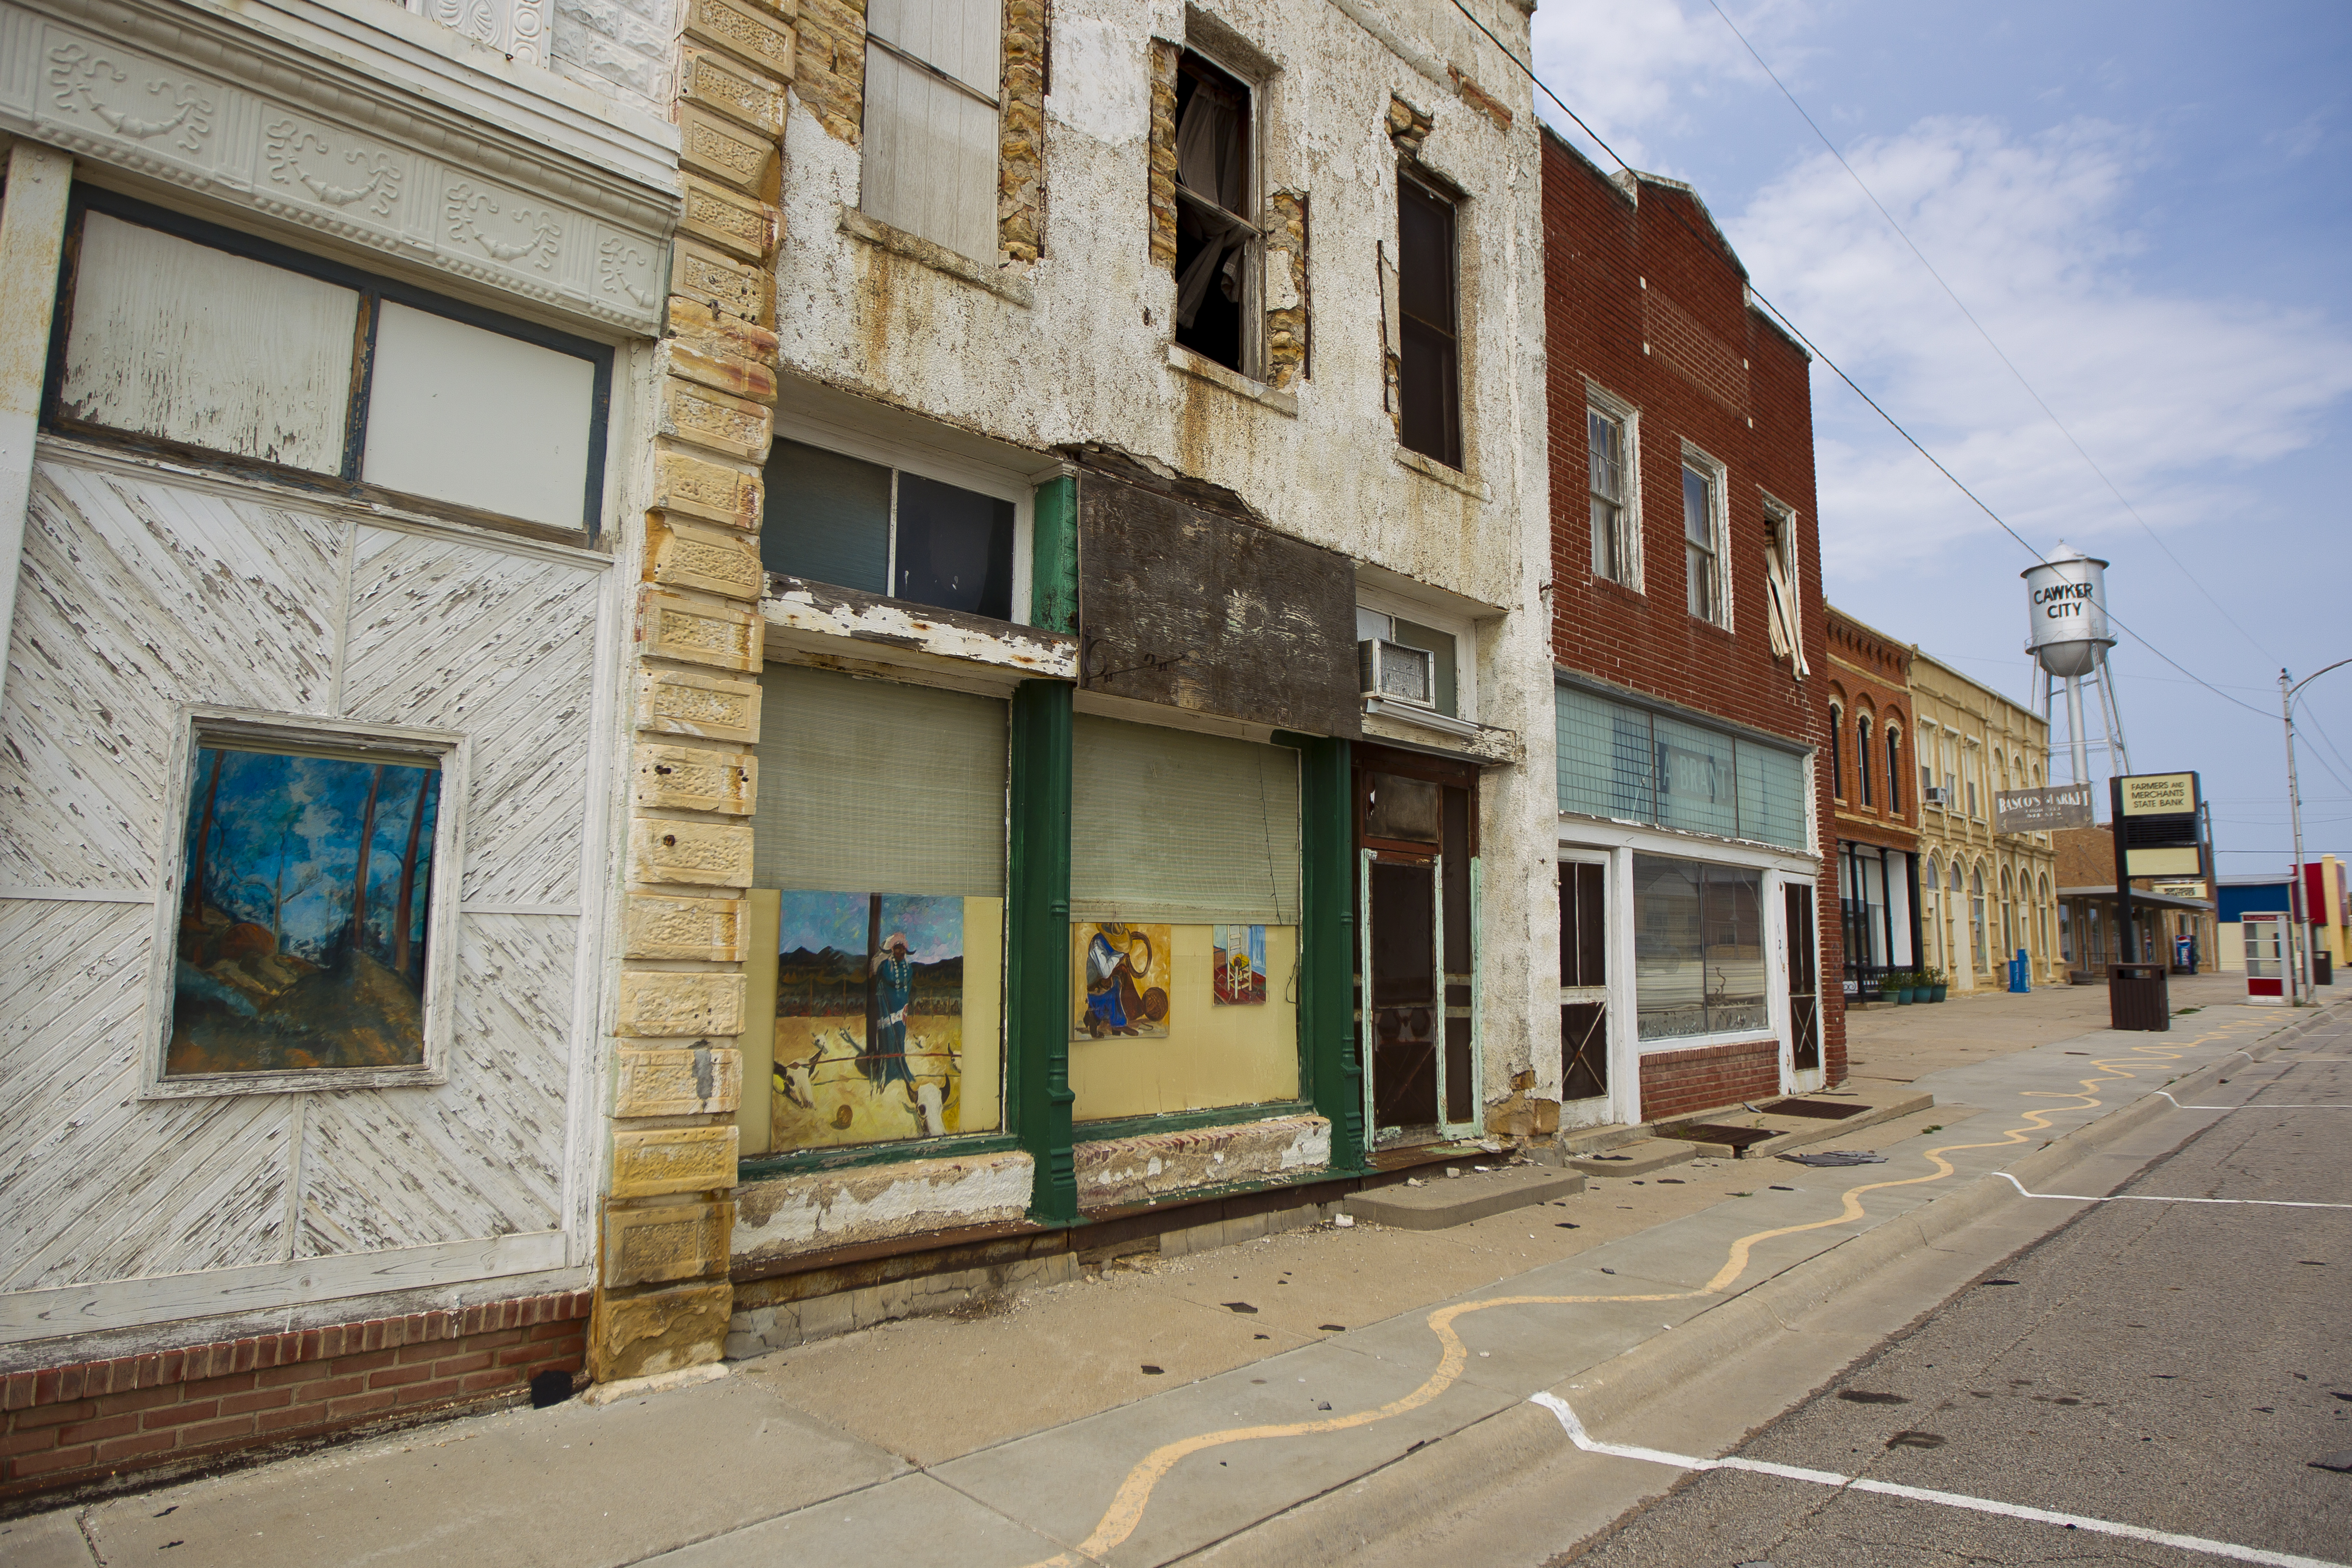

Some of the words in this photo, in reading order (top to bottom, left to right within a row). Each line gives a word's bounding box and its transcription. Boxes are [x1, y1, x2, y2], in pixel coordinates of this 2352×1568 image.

[2034, 582, 2093, 604] CAWKER
[2047, 602, 2082, 619] CITY
[1679, 754, 1727, 799] BRANT
[2131, 782, 2168, 790] FARMERS
[2132, 789, 2184, 799] MERCHANTS
[2134, 800, 2156, 808] STATE
[2159, 798, 2184, 807] BANK
